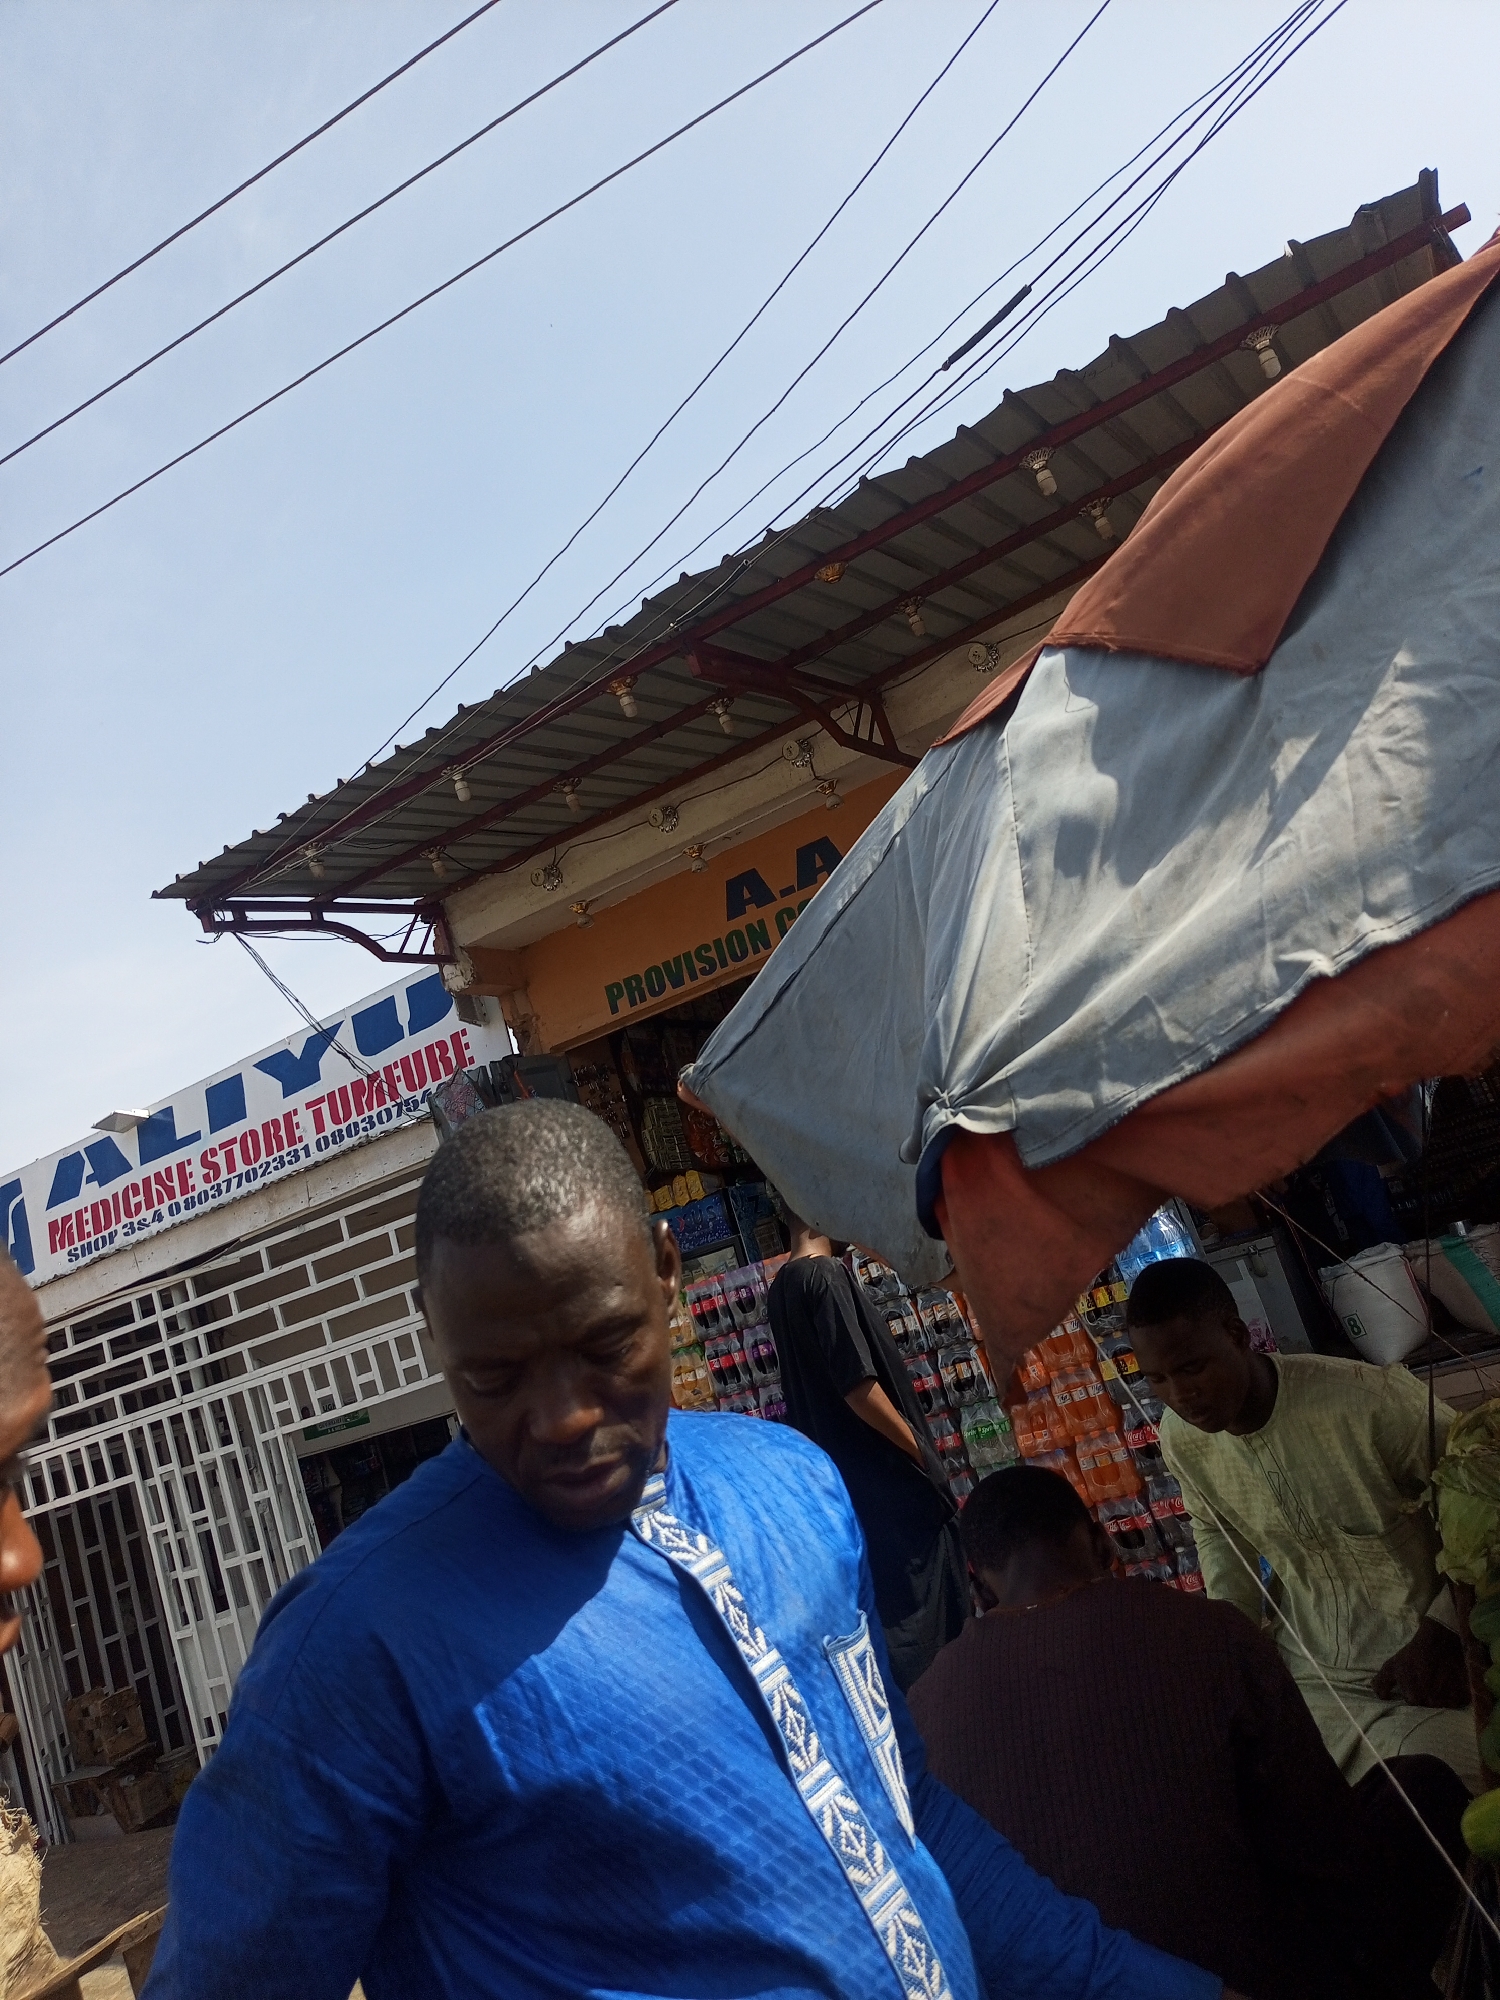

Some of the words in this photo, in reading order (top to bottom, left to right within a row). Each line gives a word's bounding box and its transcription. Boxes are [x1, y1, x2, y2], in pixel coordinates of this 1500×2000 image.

[604, 918, 772, 1016] PROVISION
[46, 972, 454, 1212] ALIYU
[48, 1158, 196, 1255] MEDICINE
[200, 1108, 303, 1184] STORE
[305, 1028, 475, 1136] TUMFURE
[67, 1229, 118, 1263] SHOP
[121, 1208, 164, 1237] 3&4
[167, 1143, 311, 1217] 08037702331
[1346, 1317, 1362, 1336] 8
